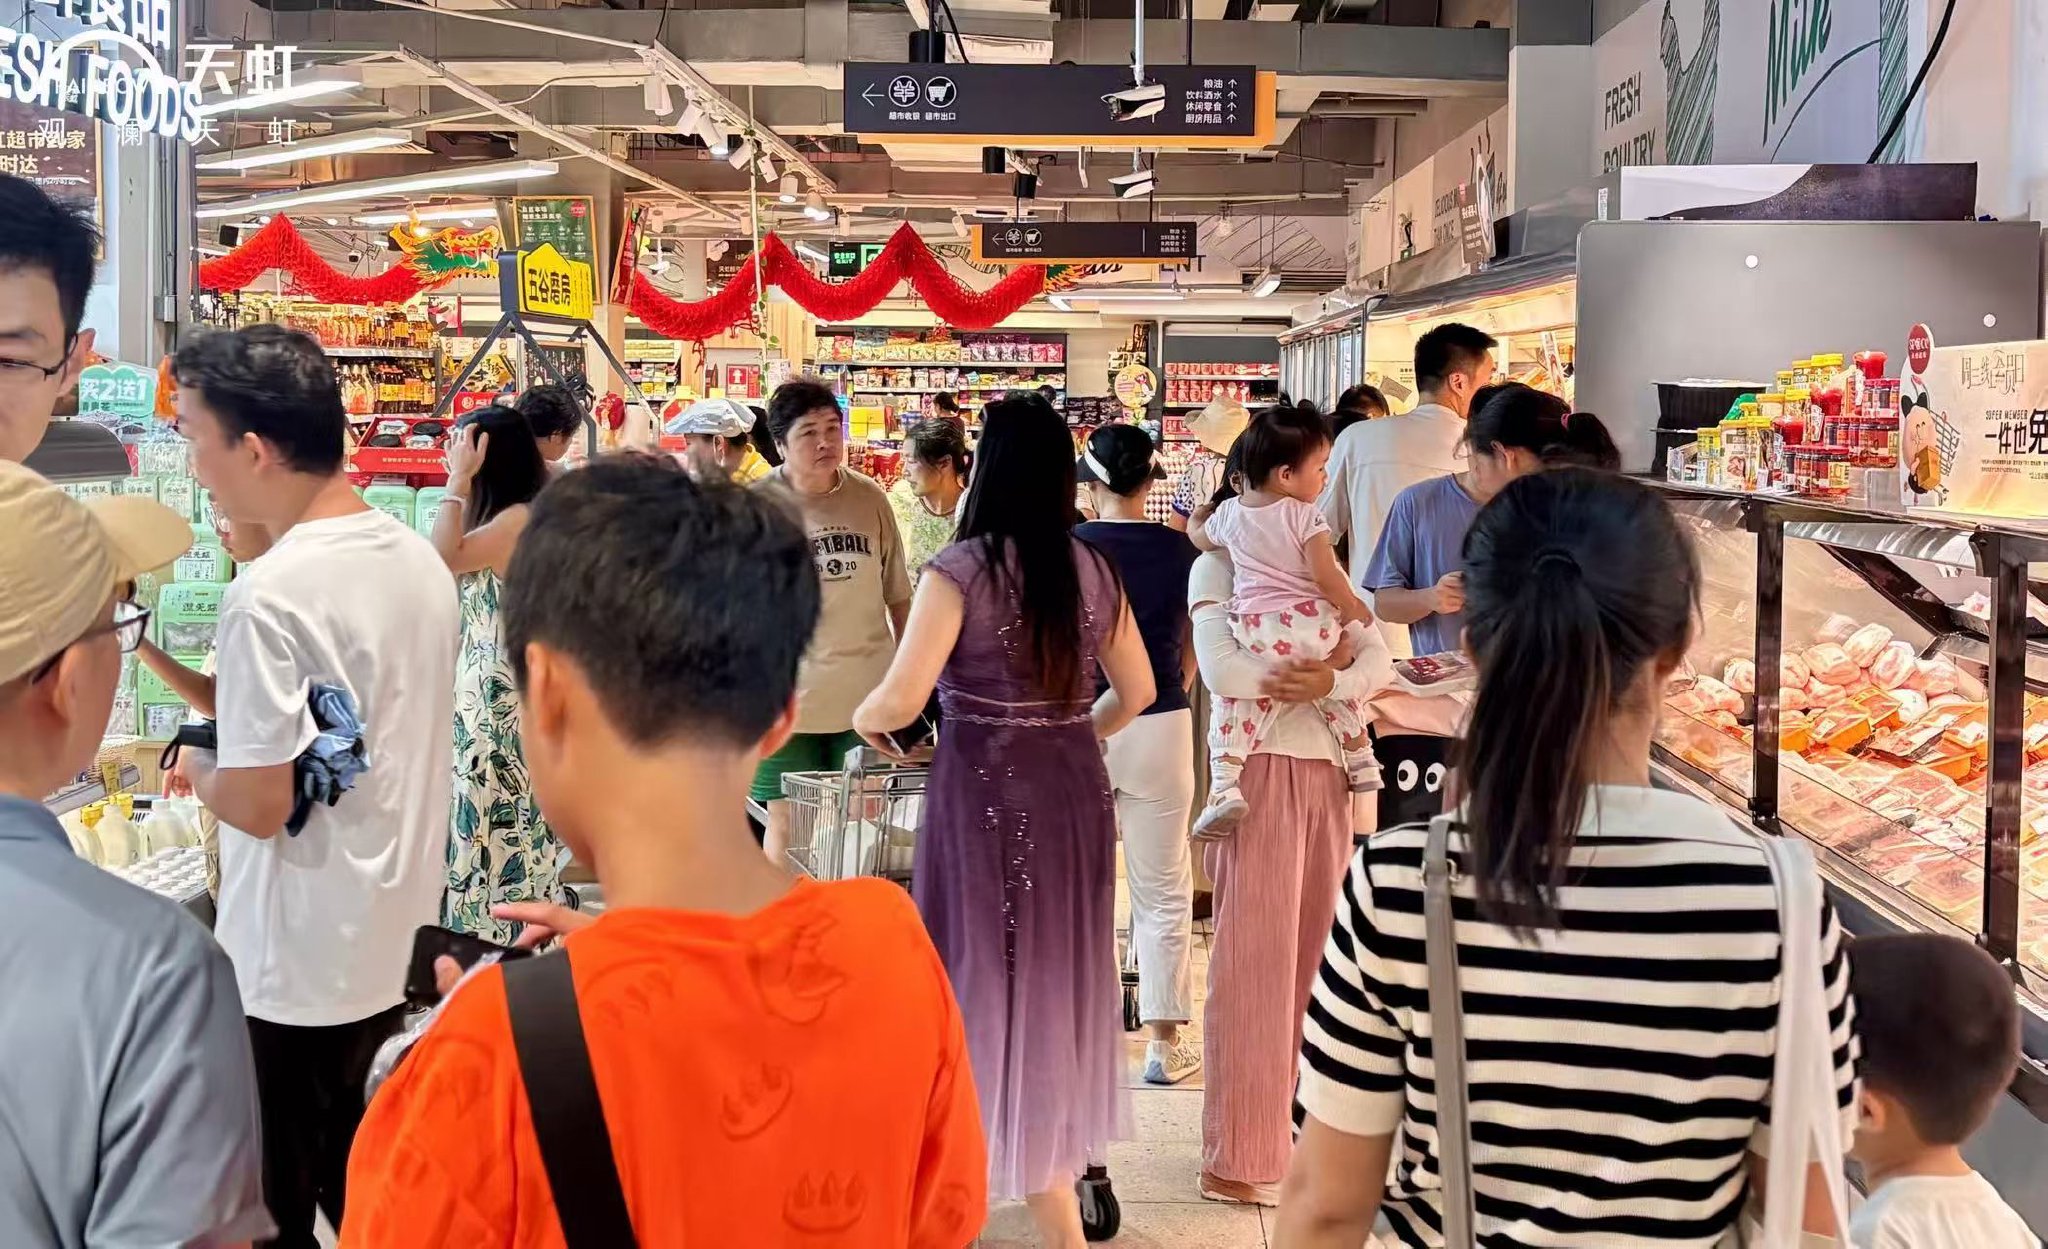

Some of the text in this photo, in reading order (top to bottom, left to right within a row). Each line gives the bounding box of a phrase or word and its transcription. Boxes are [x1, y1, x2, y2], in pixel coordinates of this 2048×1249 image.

[1204, 79, 1223, 89] 粮油
[86, 54, 203, 142] FOODS
[1186, 91, 1222, 100] 饮料酒水
[1604, 71, 1641, 131] FRESH
[1186, 102, 1222, 112] 休闲零食
[1185, 114, 1222, 124] 厨房用品
[81, 378, 147, 401] 买2送1
[845, 561, 857, 571] 20
